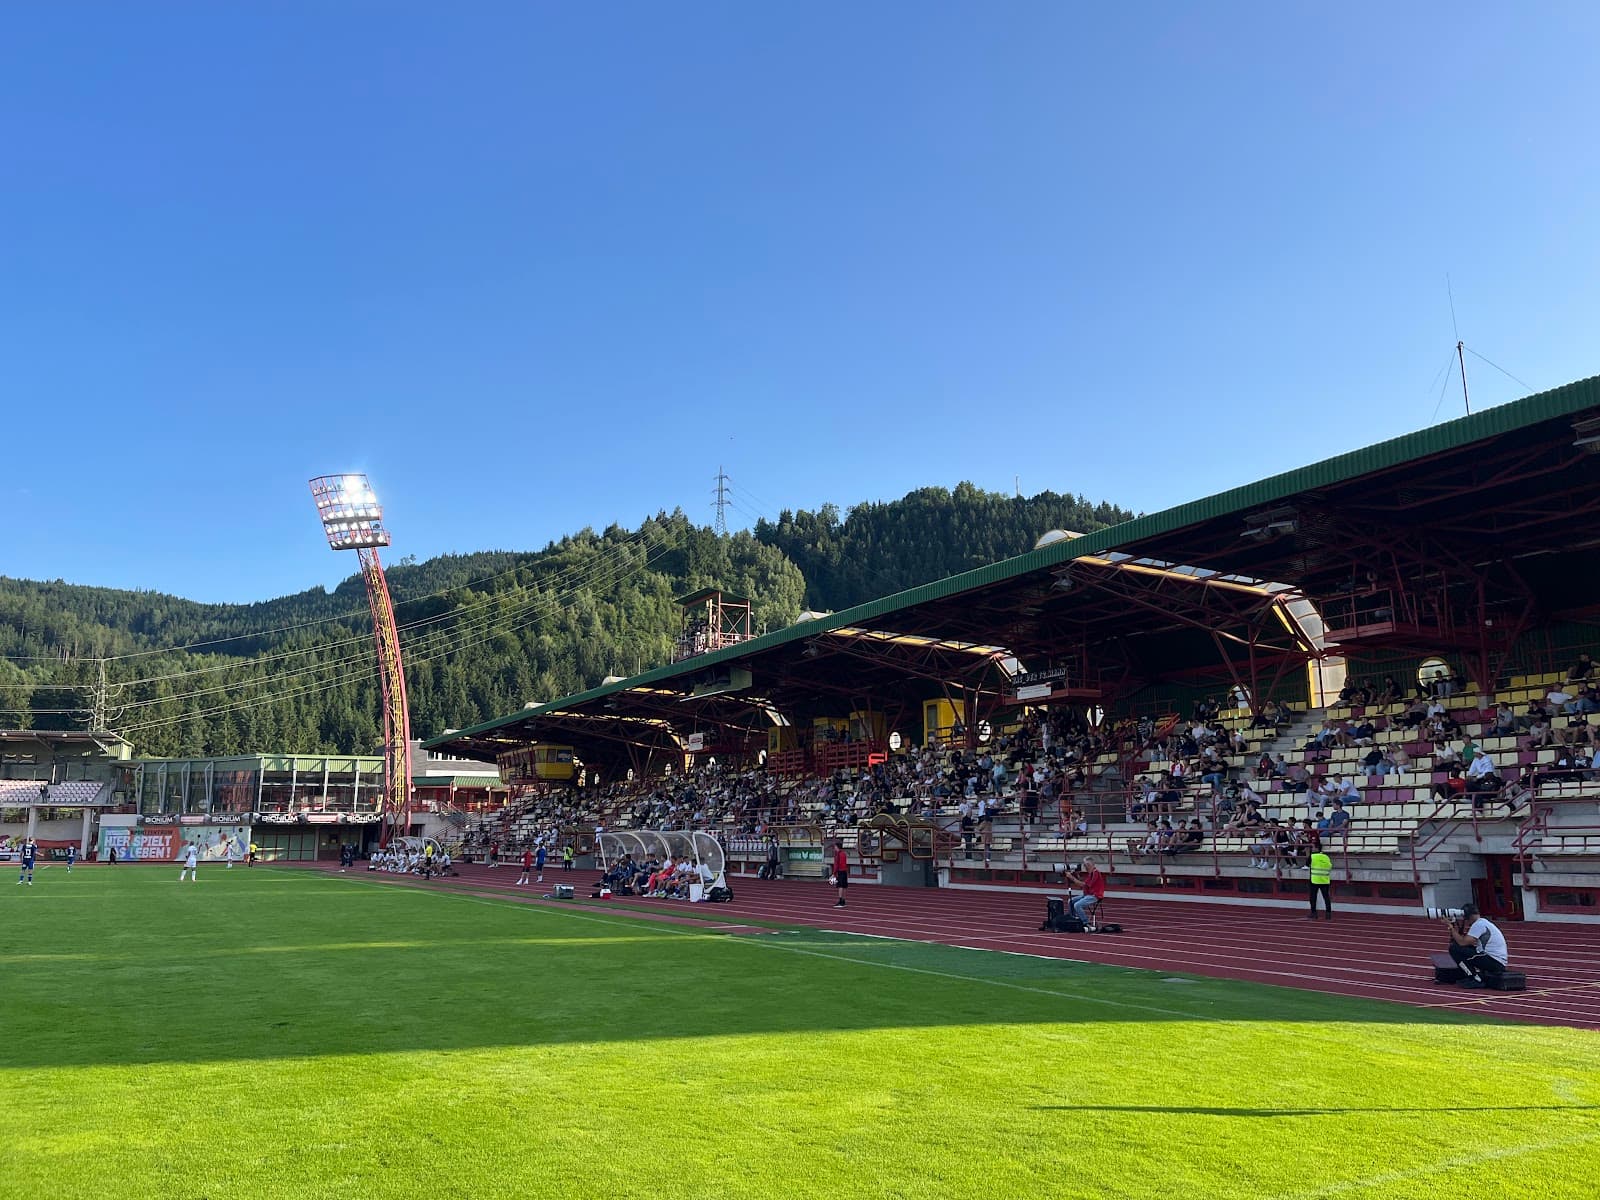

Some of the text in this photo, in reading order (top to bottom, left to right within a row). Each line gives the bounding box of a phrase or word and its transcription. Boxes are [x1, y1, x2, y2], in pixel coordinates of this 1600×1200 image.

[211, 815, 240, 823] BIONIUM
[261, 814, 298, 822] BIONIUM
[104, 835, 172, 847] HIER SPIELT
